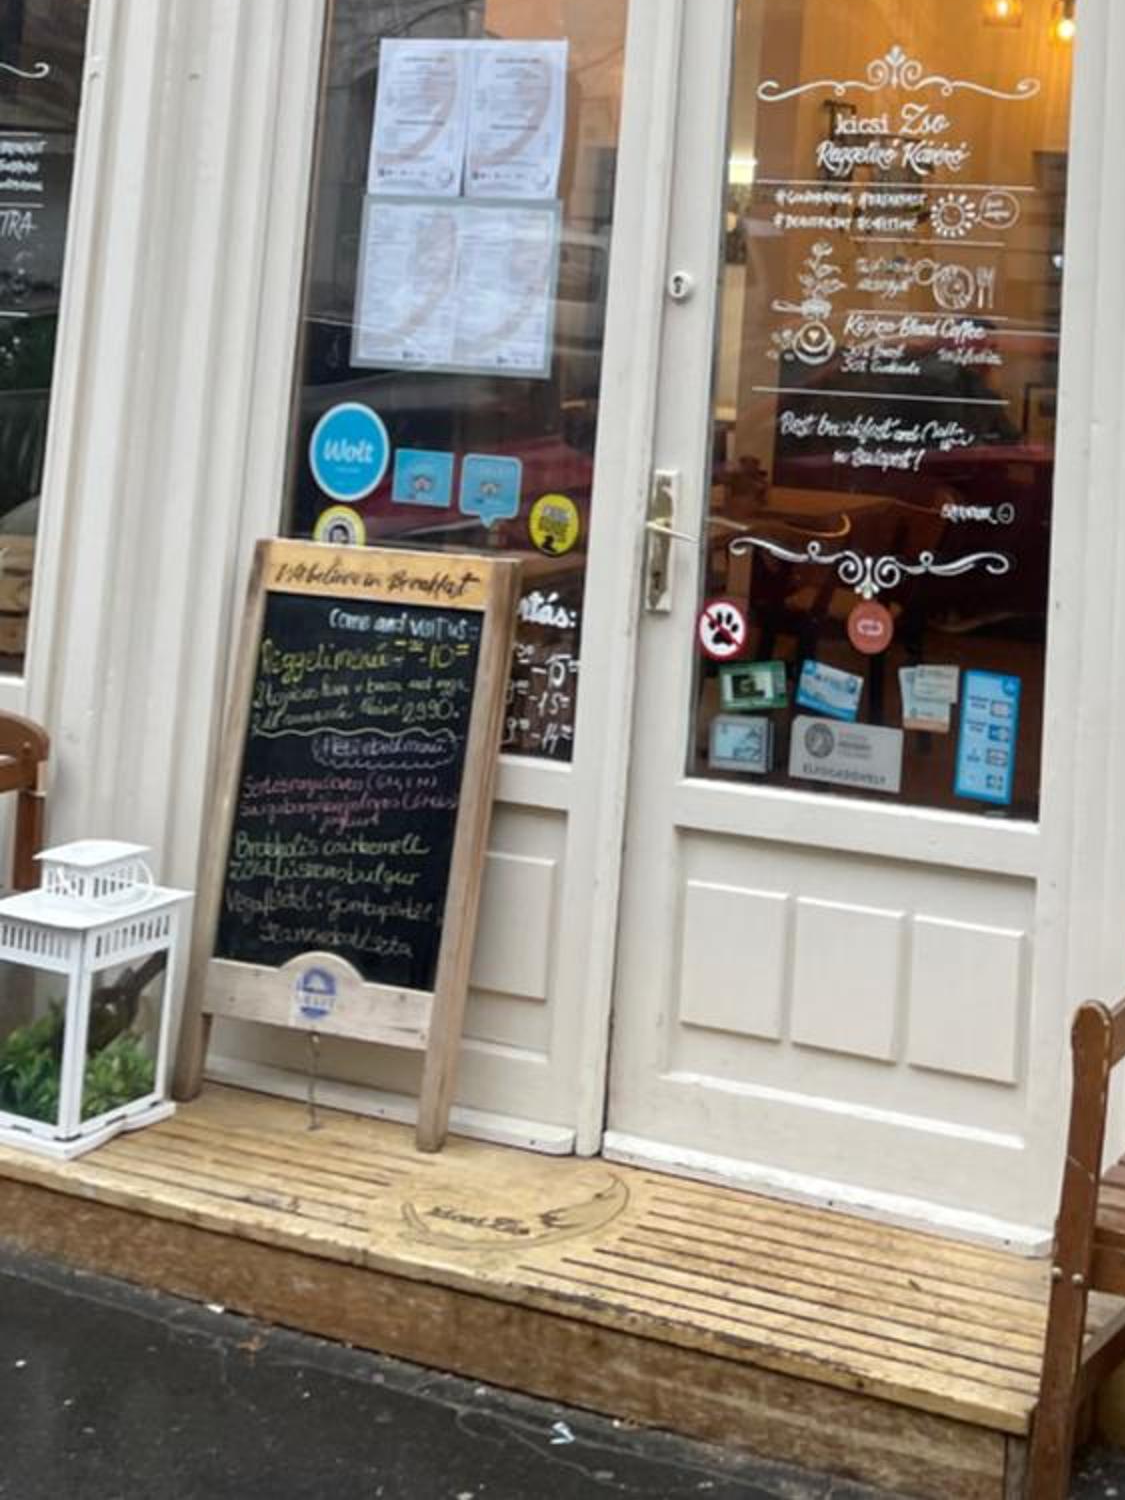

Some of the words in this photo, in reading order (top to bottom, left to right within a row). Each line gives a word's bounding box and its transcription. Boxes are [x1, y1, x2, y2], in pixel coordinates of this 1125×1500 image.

[834, 113, 890, 135] kicsi
[901, 102, 950, 133] Zso
[322, 437, 374, 464] Wolt
